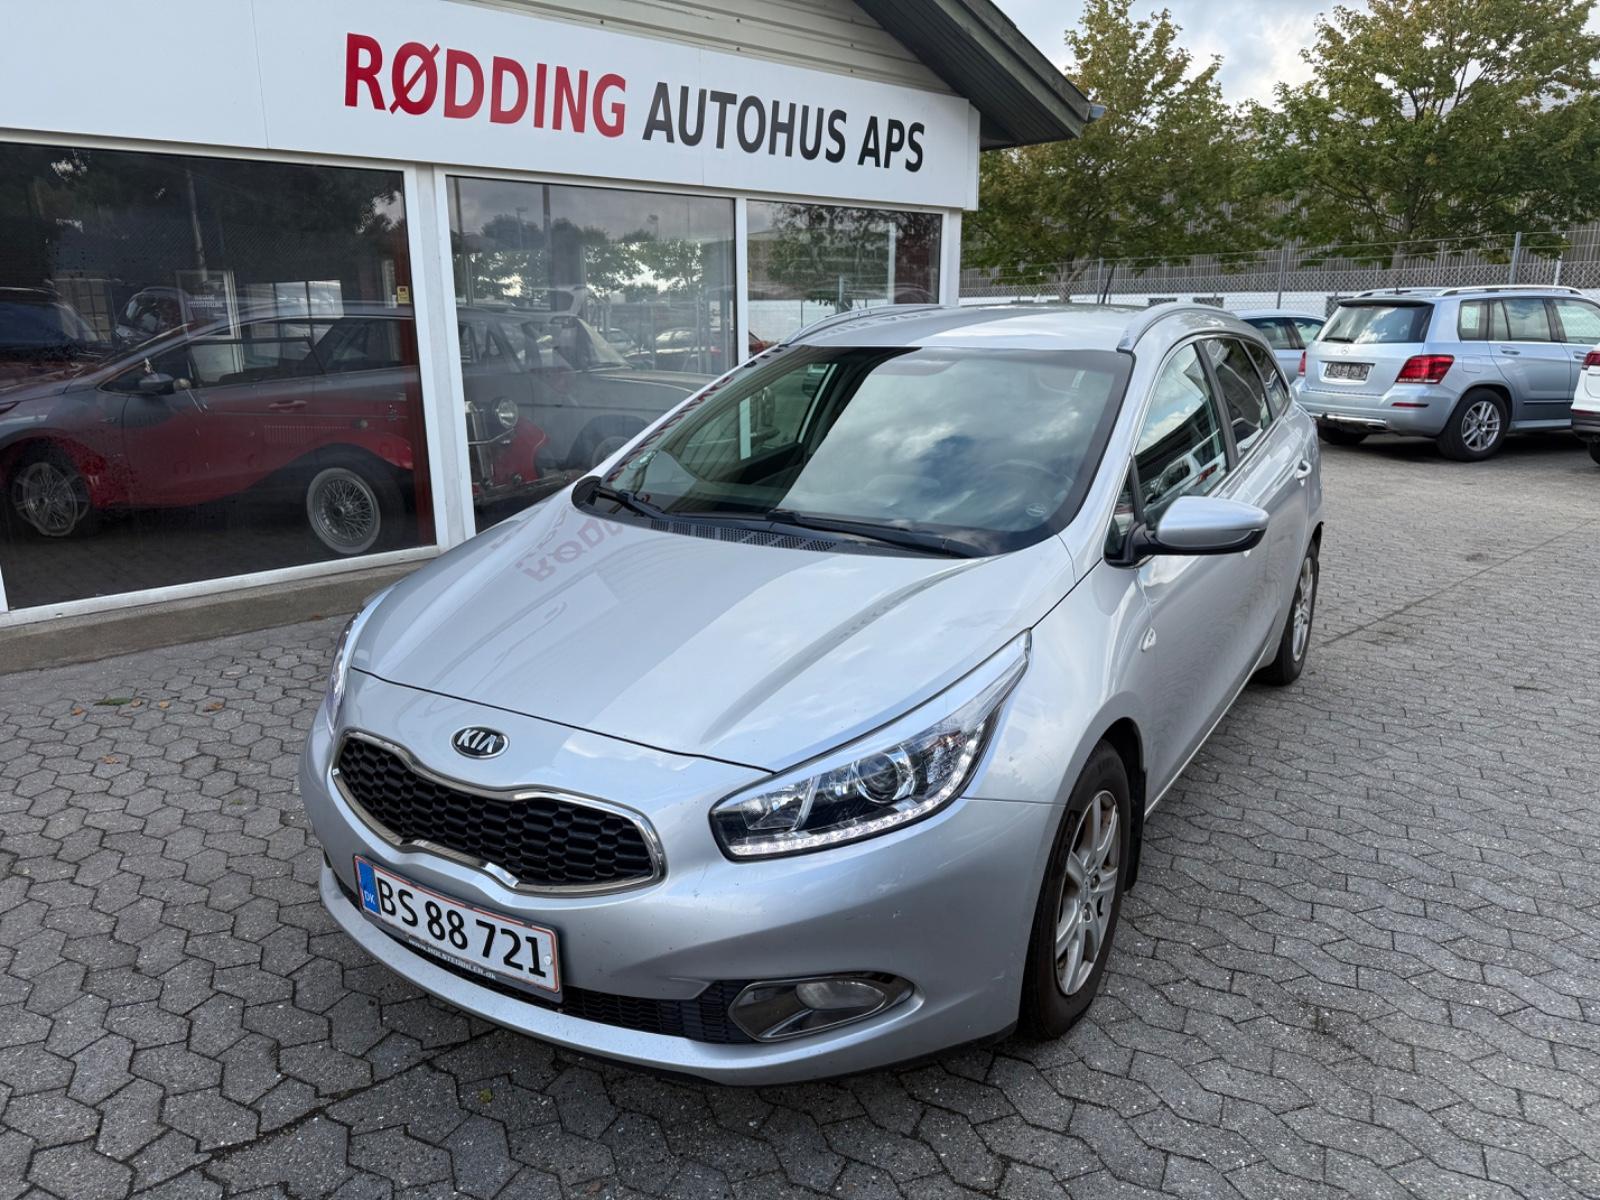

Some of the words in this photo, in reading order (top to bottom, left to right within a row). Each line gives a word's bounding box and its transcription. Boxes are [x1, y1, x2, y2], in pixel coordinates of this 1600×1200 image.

[344, 33, 627, 138] RØDDING
[642, 81, 847, 164] AUTOHUS
[857, 115, 925, 173] APS
[457, 729, 497, 753] KIA
[377, 877, 418, 927] BS
[425, 900, 468, 950] 88
[476, 919, 546, 978] 721
